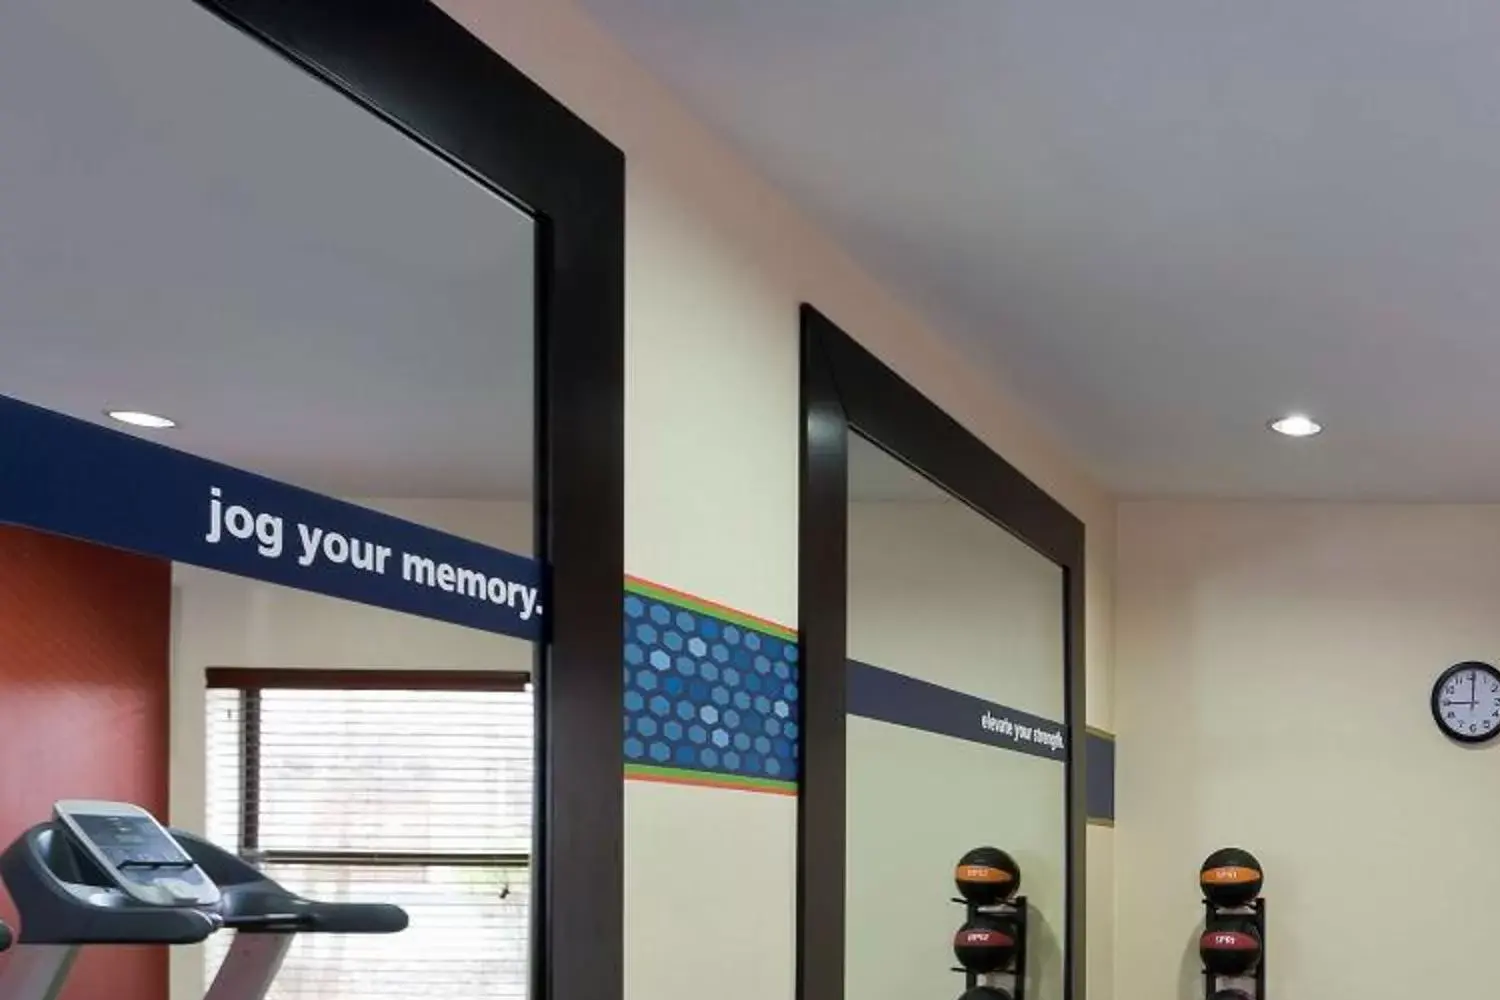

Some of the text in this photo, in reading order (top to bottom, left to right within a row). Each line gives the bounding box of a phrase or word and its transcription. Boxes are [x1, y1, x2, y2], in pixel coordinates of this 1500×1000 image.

[205, 487, 543, 621] jog your memory.
[981, 710, 1013, 736] elevate
[1013, 723, 1032, 742] your
